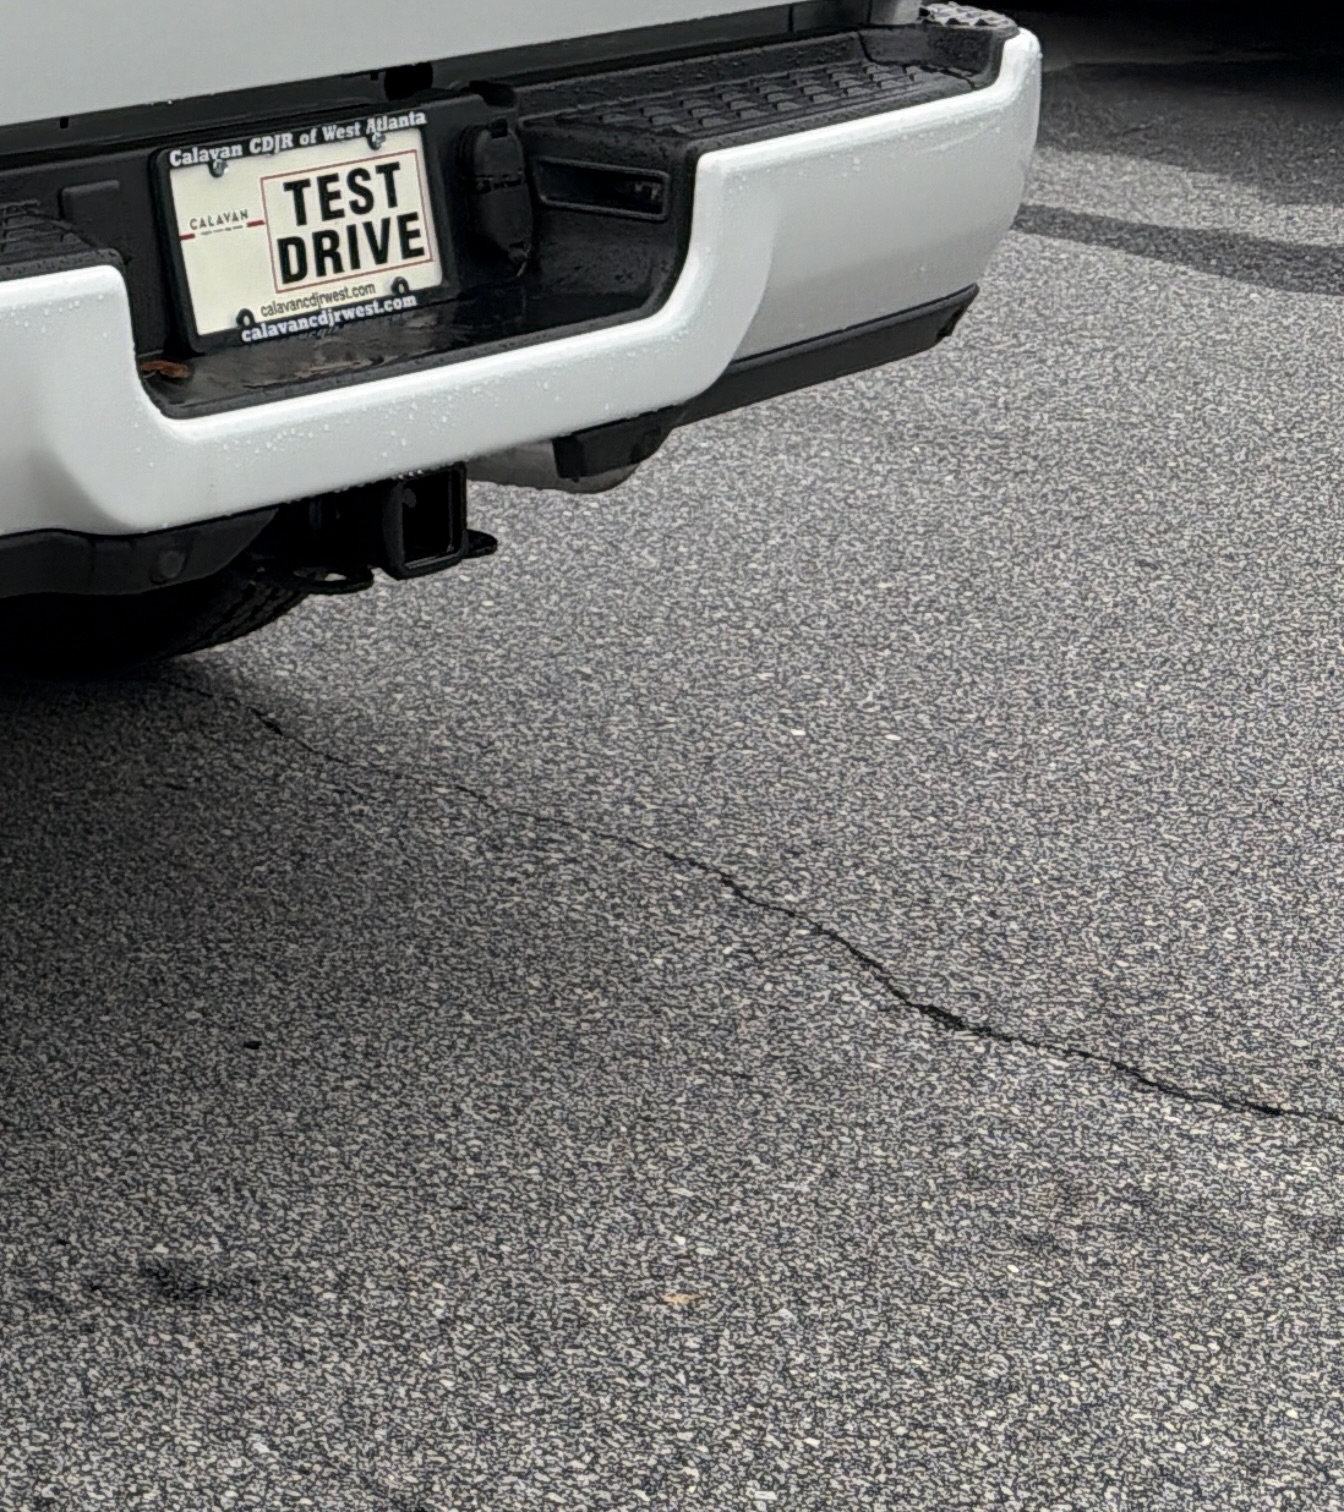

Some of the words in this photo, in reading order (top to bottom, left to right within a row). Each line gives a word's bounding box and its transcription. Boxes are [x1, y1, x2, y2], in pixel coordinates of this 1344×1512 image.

[168, 143, 244, 168] Calavan
[248, 131, 294, 155] CDJR
[299, 130, 317, 147] of
[321, 121, 361, 142] West
[365, 111, 428, 135] Atlanta
[189, 208, 249, 231] CALAVAN
[282, 160, 402, 227] TEST
[276, 212, 427, 285] DRIVE
[240, 294, 417, 343] calavancdjrwest.com
[259, 283, 376, 318] calavancdjrwest.com
